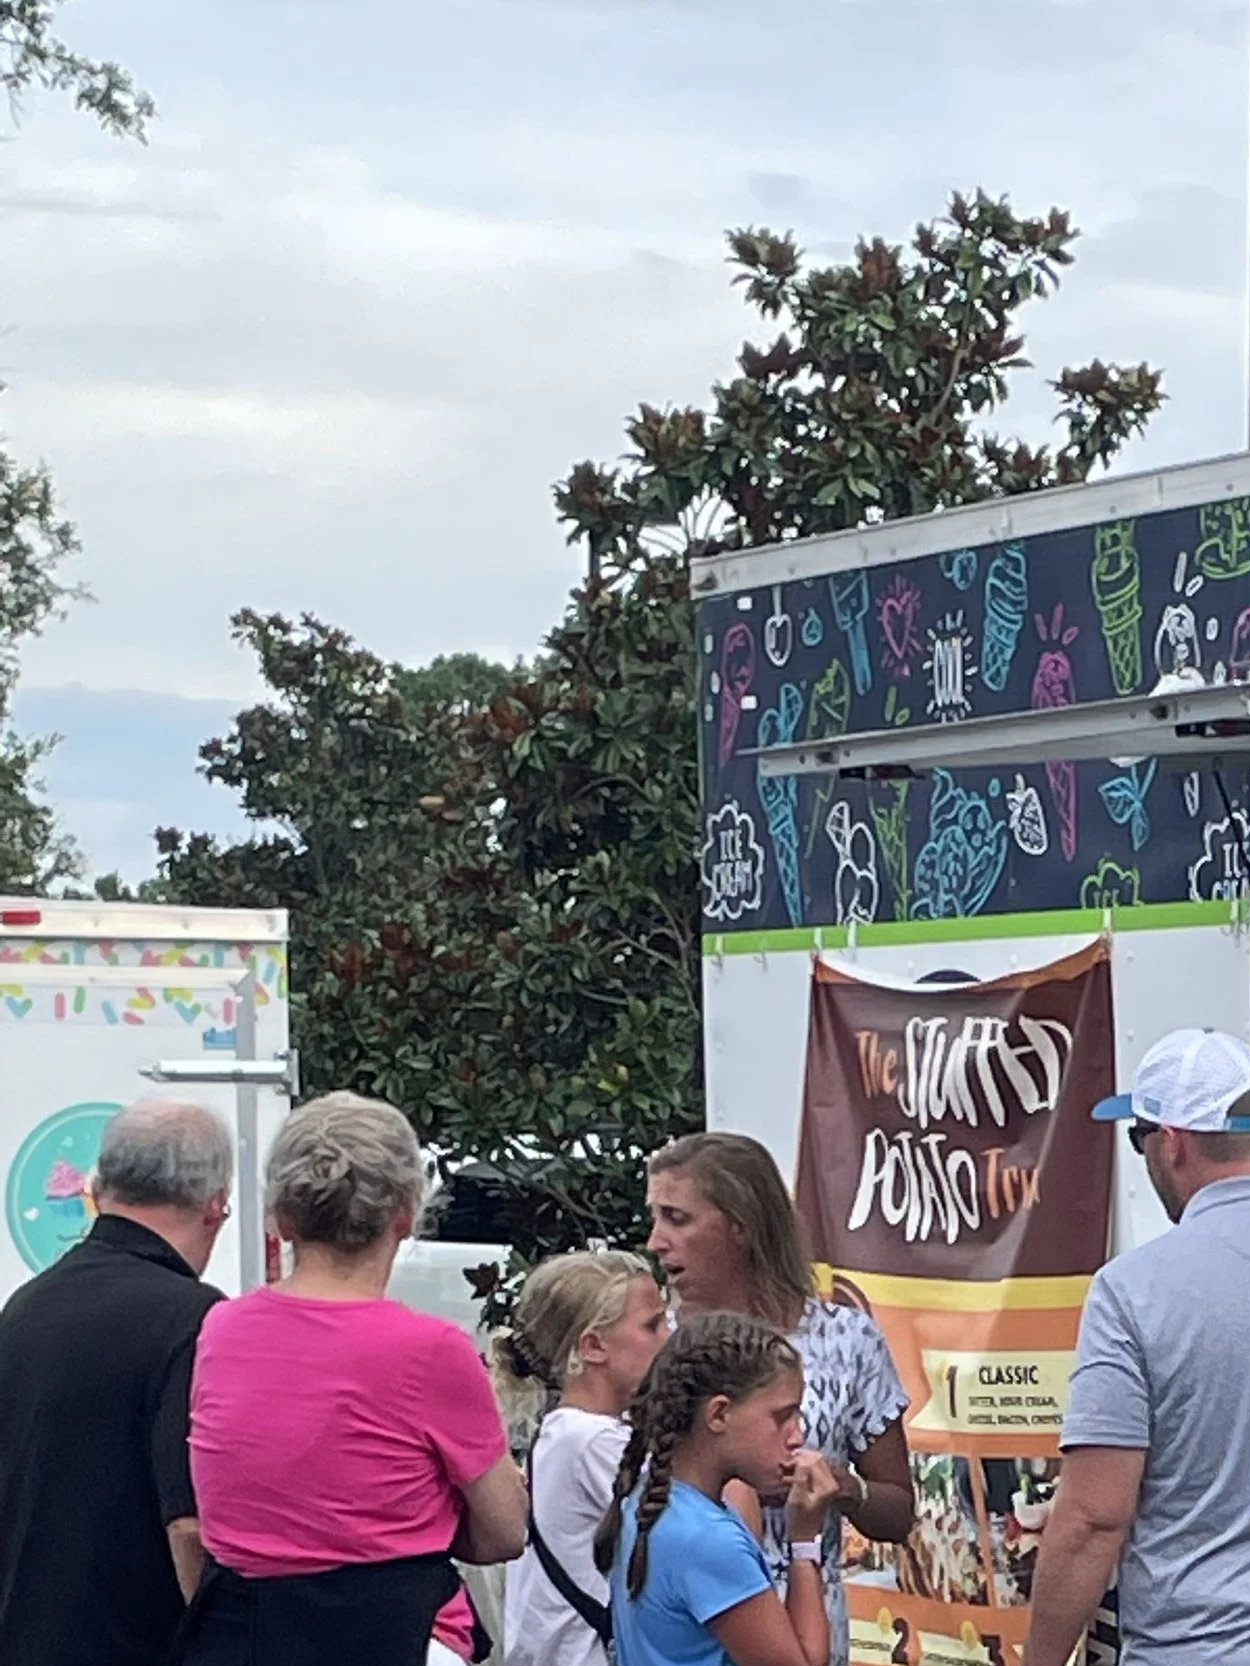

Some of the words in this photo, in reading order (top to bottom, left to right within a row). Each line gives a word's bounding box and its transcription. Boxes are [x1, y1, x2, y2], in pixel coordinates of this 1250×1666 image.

[855, 1030, 898, 1099] The
[897, 1015, 1074, 1130] STUFFED
[848, 1128, 981, 1245] POTATO
[946, 1365, 958, 1418] 1
[979, 1365, 1040, 1385] CLASSIC
[891, 1617, 910, 1666] 2
